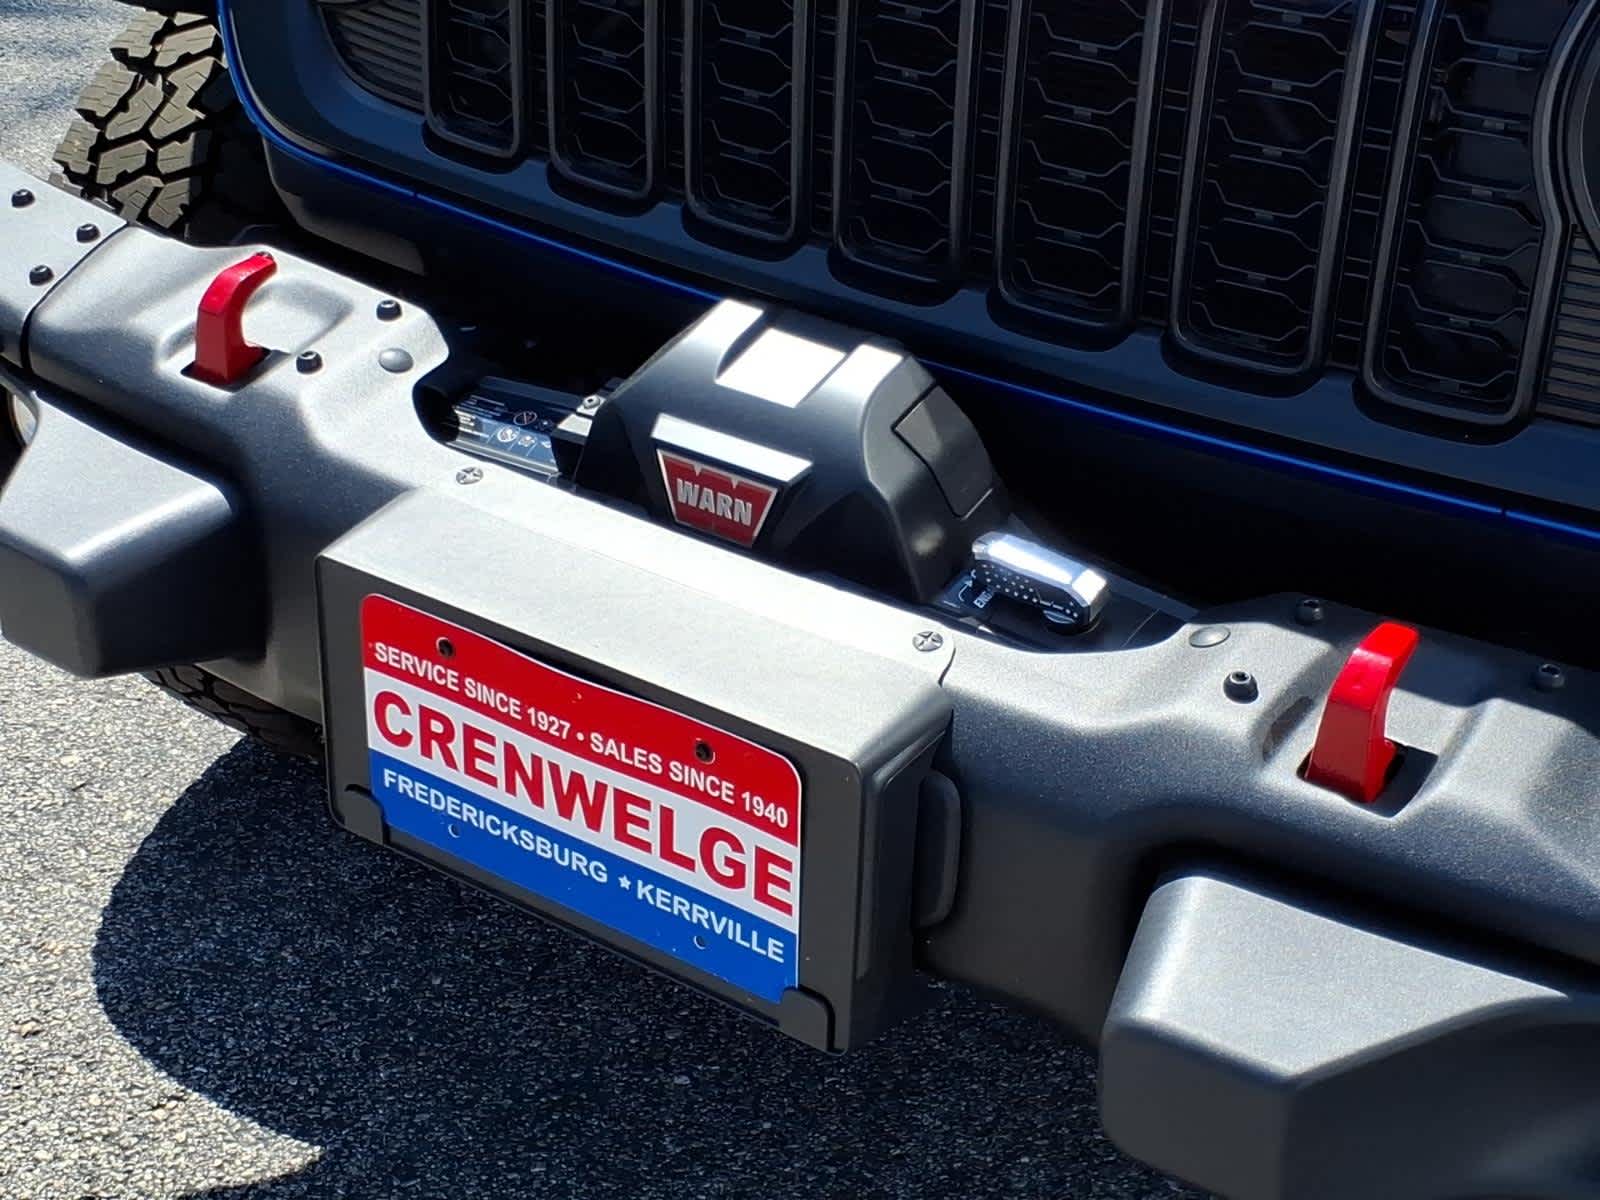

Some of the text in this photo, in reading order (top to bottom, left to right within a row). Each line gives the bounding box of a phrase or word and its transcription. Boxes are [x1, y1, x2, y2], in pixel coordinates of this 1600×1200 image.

[676, 478, 752, 526] WARN
[373, 690, 794, 918] CRENWELGE
[374, 642, 789, 829] SERVICE SINCE 1927 SALES SINCE 1940
[383, 768, 785, 963] FREDERICKSBURG KERRVILLE
